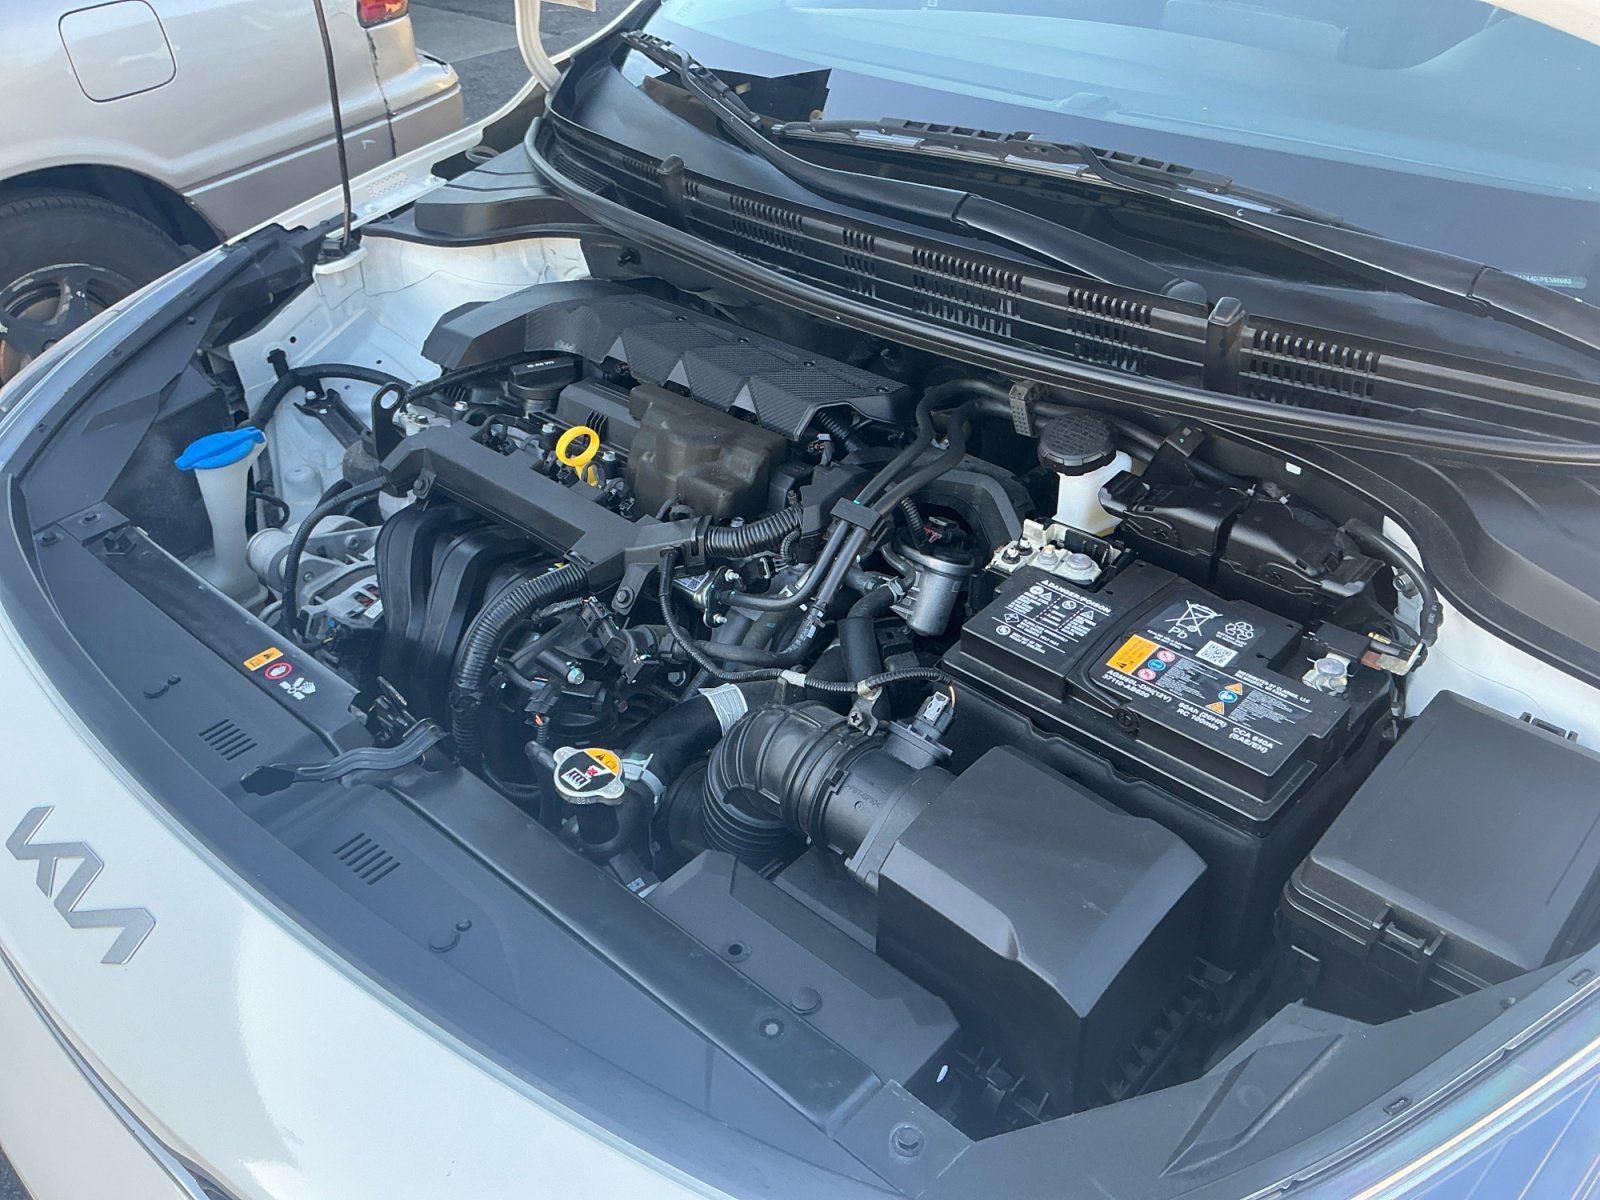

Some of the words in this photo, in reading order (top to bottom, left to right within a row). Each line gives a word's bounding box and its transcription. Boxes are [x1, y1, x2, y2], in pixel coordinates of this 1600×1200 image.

[1047, 582, 1112, 613] DANGER/POISON
[1168, 626, 1189, 639] Pb
[1176, 708, 1190, 718] RC
[1191, 714, 1220, 731] 100min
[1178, 702, 1200, 715] 60Ah
[1199, 711, 1228, 728] (20HR)
[1232, 727, 1251, 739] CCA
[1252, 736, 1274, 749] 640A
